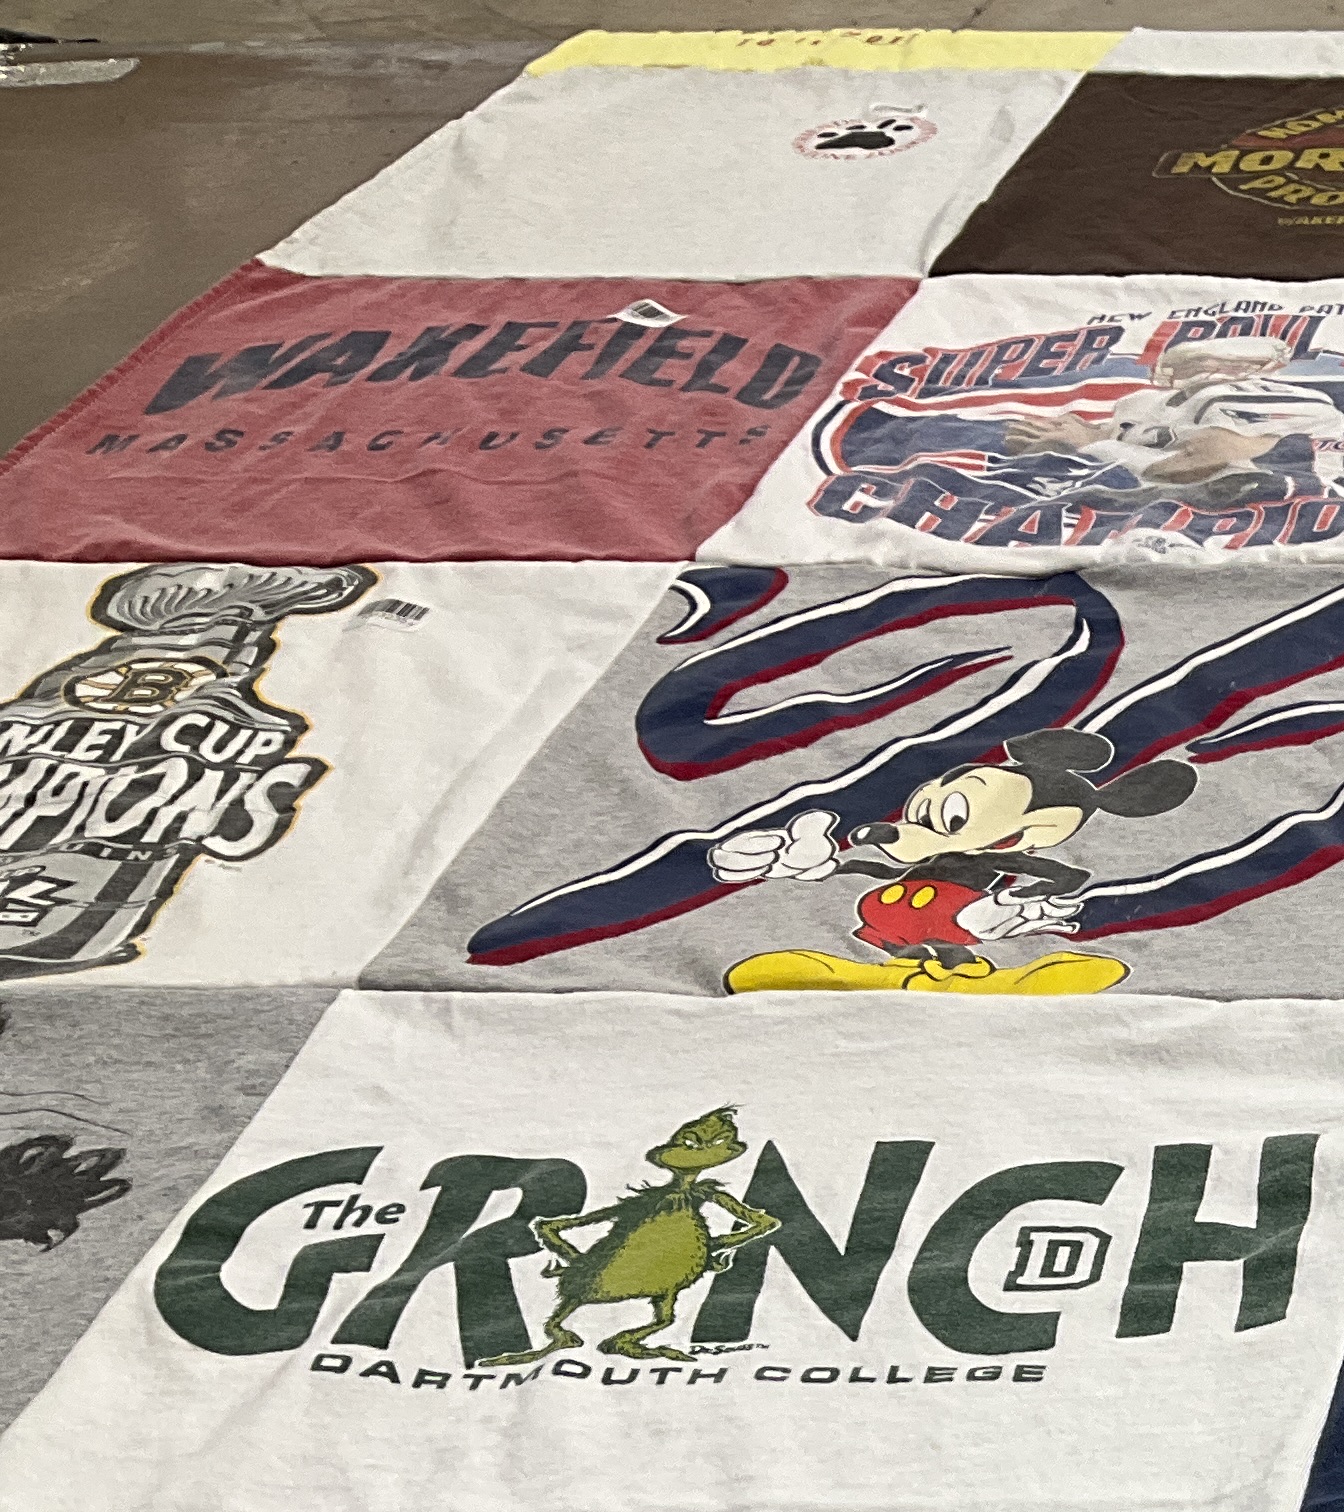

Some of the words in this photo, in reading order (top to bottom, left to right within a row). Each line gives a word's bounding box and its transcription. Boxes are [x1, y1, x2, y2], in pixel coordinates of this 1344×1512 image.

[1087, 309, 1153, 326] NEW
[1167, 299, 1285, 321] ENGLAND
[144, 318, 823, 416] WAKEFIELD
[842, 323, 1126, 400] SUPER
[85, 424, 770, 456] MASSACHUSETTS
[115, 667, 192, 703] B
[160, 713, 285, 765] CUP
[299, 1193, 406, 1232] The
[155, 1125, 1321, 1370] GRNCH
[309, 1352, 730, 1391] DARTMOUTH
[753, 1363, 1047, 1386] COLLEGE
